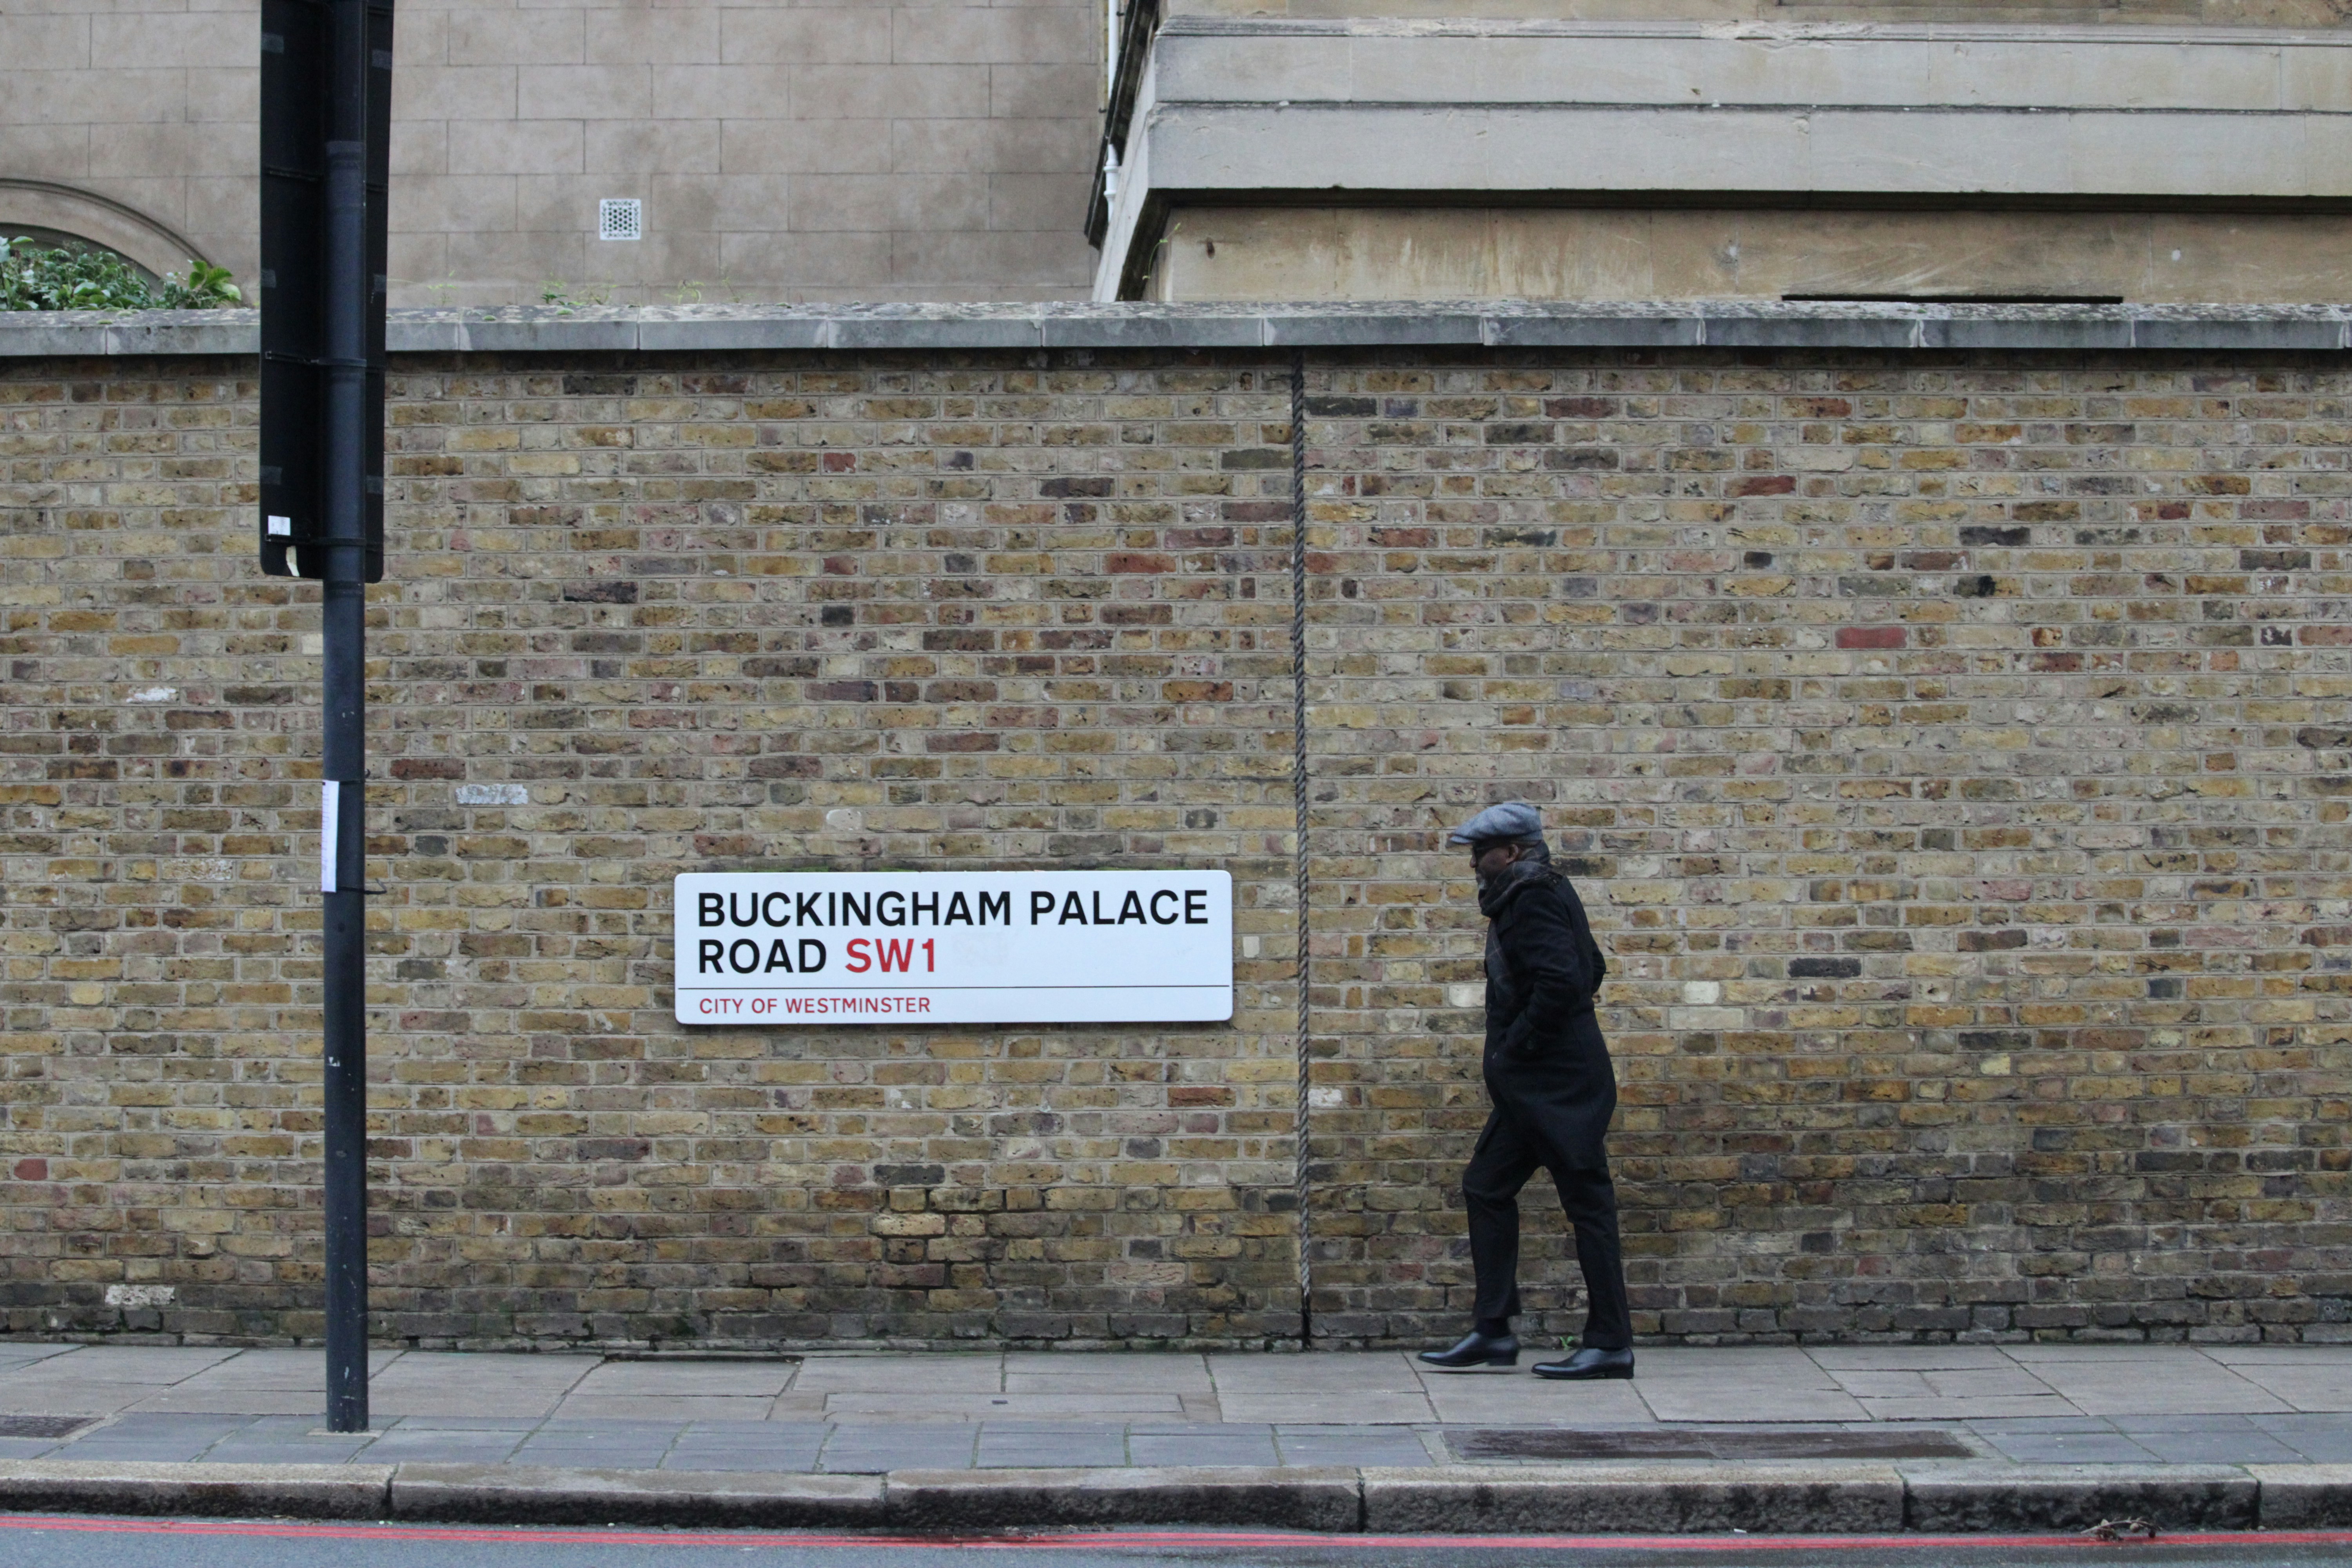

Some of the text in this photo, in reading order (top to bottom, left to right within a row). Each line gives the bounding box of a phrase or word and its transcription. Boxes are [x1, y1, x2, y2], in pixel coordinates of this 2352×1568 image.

[699, 890, 1208, 927] BUCKINGHAM PALACE
[699, 938, 935, 974] ROAD SW1
[700, 997, 930, 1013] CITY OF WESTMINSTER
